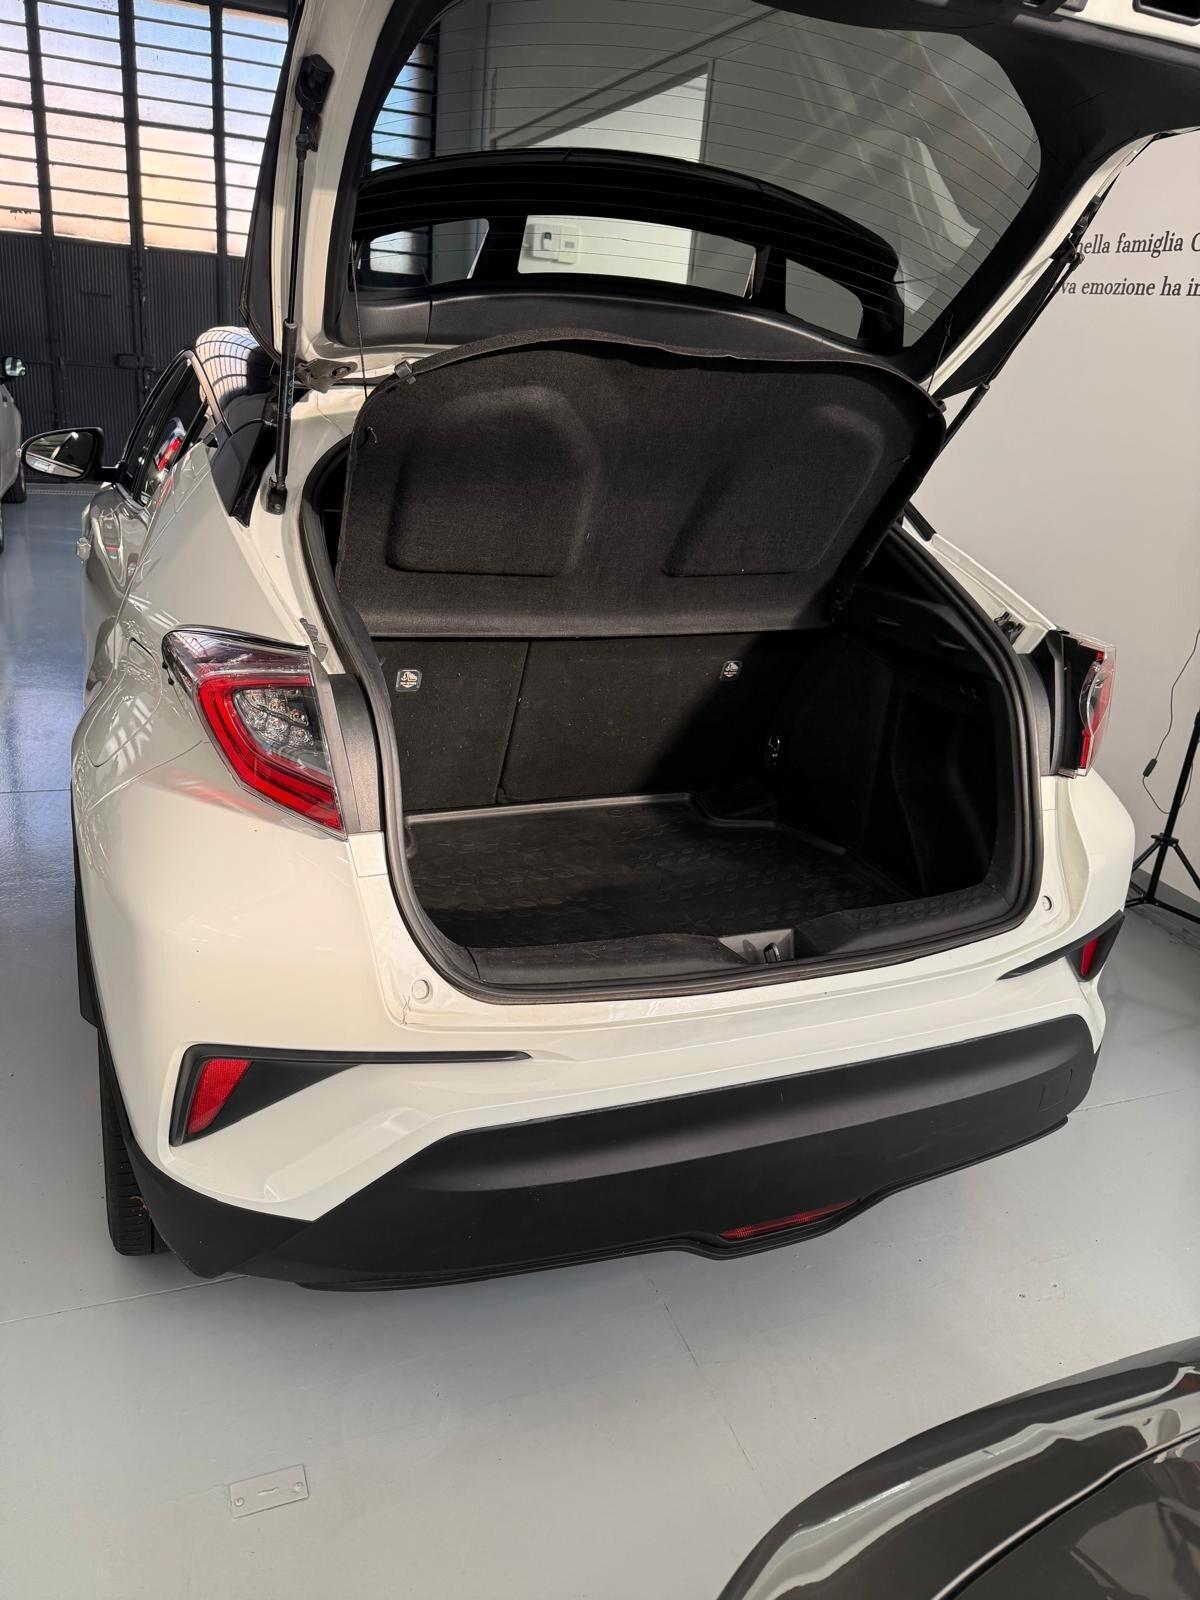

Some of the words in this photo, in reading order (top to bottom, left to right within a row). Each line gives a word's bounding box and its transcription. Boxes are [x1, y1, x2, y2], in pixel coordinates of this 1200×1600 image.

[1115, 230, 1184, 259] famiglia
[1081, 277, 1156, 295] emozione
[1159, 275, 1182, 296] ha
